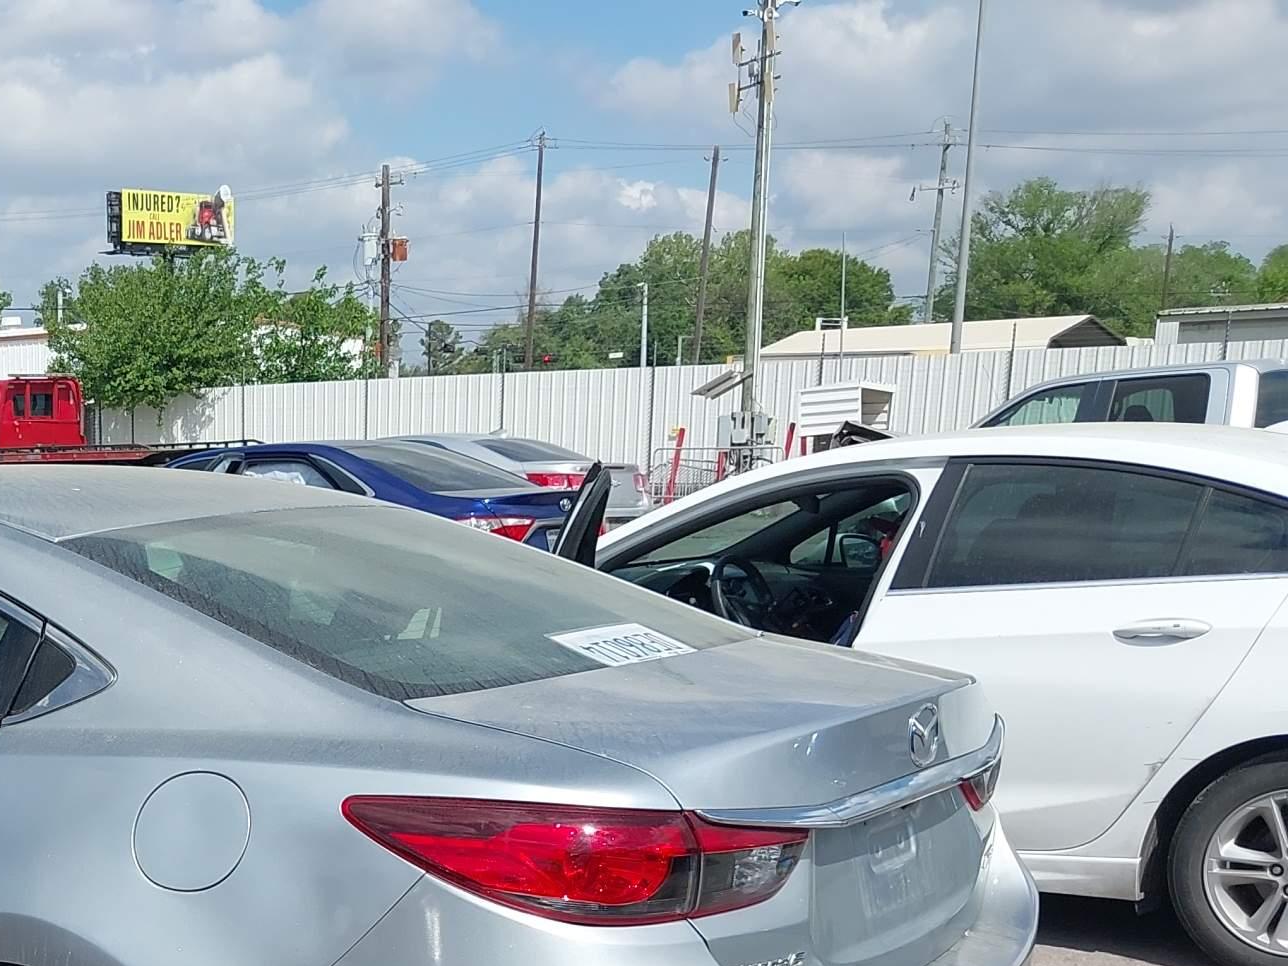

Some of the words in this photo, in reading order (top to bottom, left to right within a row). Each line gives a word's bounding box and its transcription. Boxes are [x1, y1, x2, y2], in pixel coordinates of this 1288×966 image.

[127, 191, 181, 213] INJURED?
[127, 220, 145, 240] JIM
[148, 221, 182, 241] ADLER
